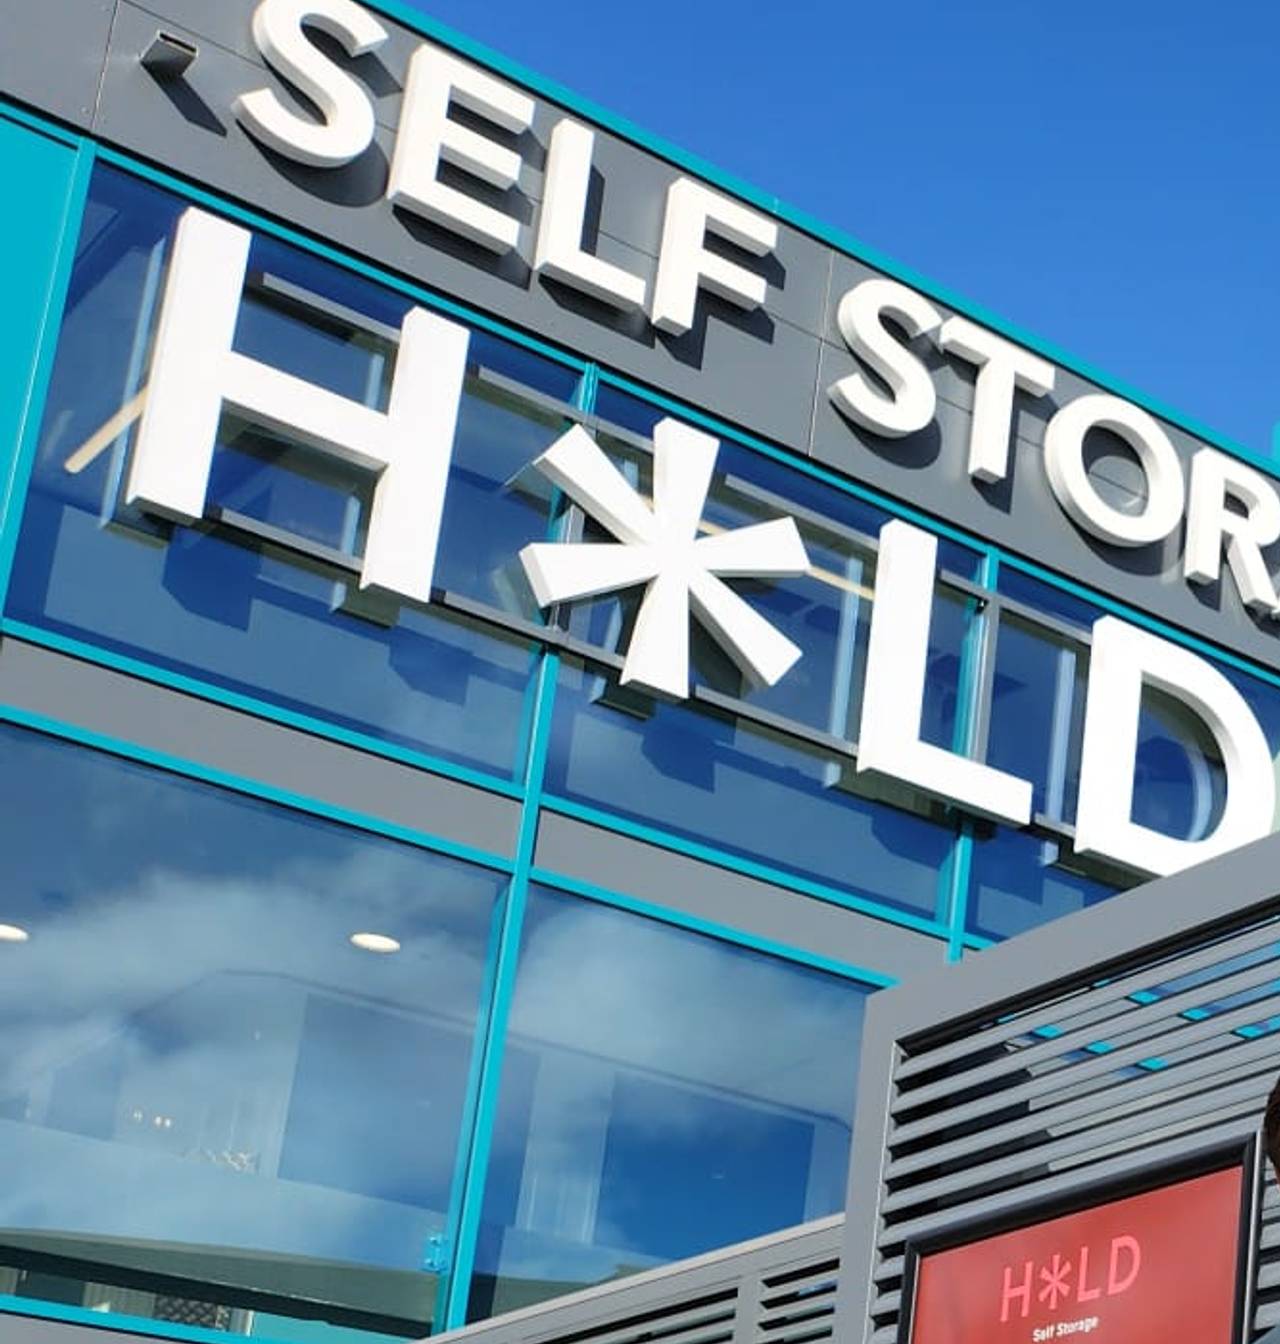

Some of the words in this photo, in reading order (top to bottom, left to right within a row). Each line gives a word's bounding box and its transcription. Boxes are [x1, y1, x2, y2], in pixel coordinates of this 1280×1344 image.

[234, 0, 777, 336] SELF
[1032, 1326, 1055, 1343] Self
[1055, 1316, 1100, 1338] Storage
